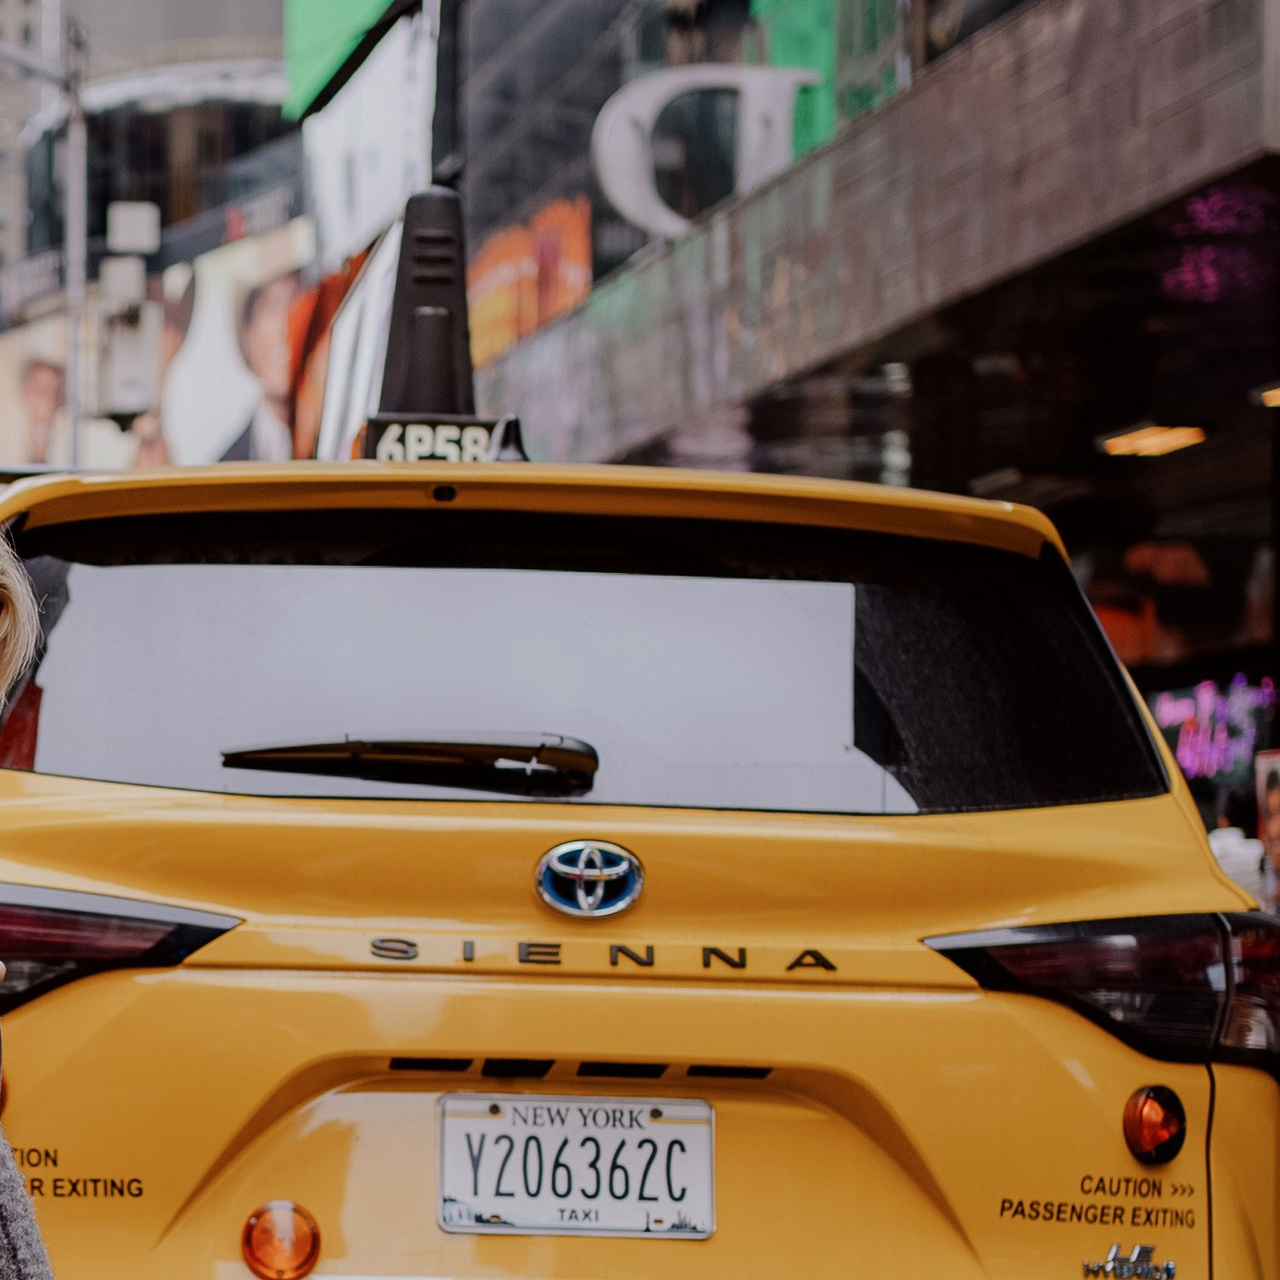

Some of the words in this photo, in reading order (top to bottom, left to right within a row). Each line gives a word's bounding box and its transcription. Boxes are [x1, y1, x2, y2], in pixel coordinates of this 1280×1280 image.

[371, 938, 838, 972] SIENNA
[512, 1106, 570, 1128] NEW
[578, 1107, 645, 1130] YORK
[465, 1132, 688, 1203] Y206362C
[52, 1177, 144, 1198] EXITING
[1080, 1174, 1163, 1199] CAUTION
[558, 1208, 600, 1223] TAXI
[999, 1198, 1126, 1227] PASSENGER
[1131, 1206, 1196, 1229] EXITING
